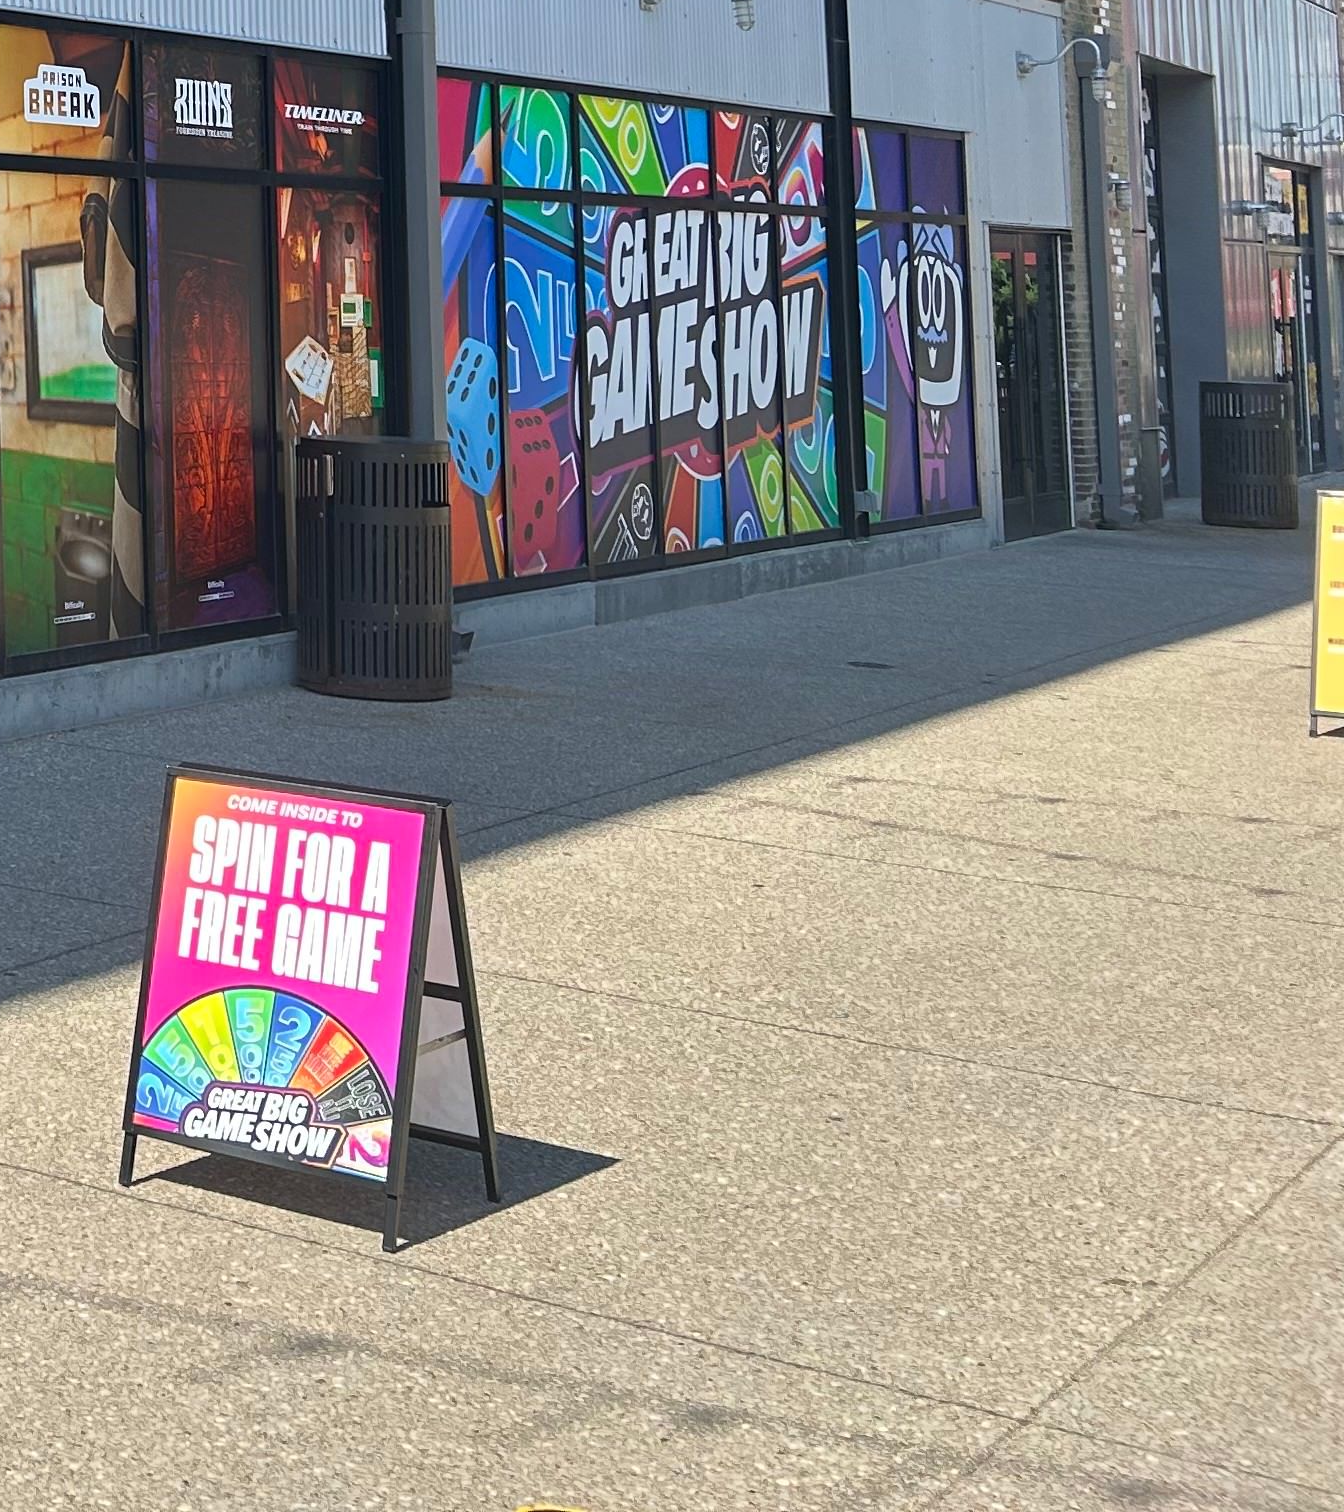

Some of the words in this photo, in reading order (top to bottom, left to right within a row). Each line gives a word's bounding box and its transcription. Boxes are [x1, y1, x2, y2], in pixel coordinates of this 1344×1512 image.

[28, 88, 96, 120] BREAK
[42, 70, 82, 88] PRISON
[173, 77, 233, 128] RUINS
[284, 104, 363, 125] TIMELINER
[611, 210, 705, 308] GREAT
[704, 190, 769, 309] BIG
[575, 298, 698, 449] GAME
[697, 287, 814, 430] SHOW
[227, 794, 276, 816] COME
[280, 802, 339, 826] INSIDE
[341, 811, 363, 829] TO
[189, 814, 277, 895] SPIN
[282, 828, 356, 908] FOR
[361, 840, 390, 915] A
[178, 886, 267, 972] FREE
[271, 903, 385, 994] GAME
[207, 1087, 265, 1113] GREAT
[261, 1093, 309, 1125] BIG
[347, 1069, 386, 1119] LOSE
[184, 1107, 257, 1145] GAME
[251, 1121, 337, 1159] SHOW
